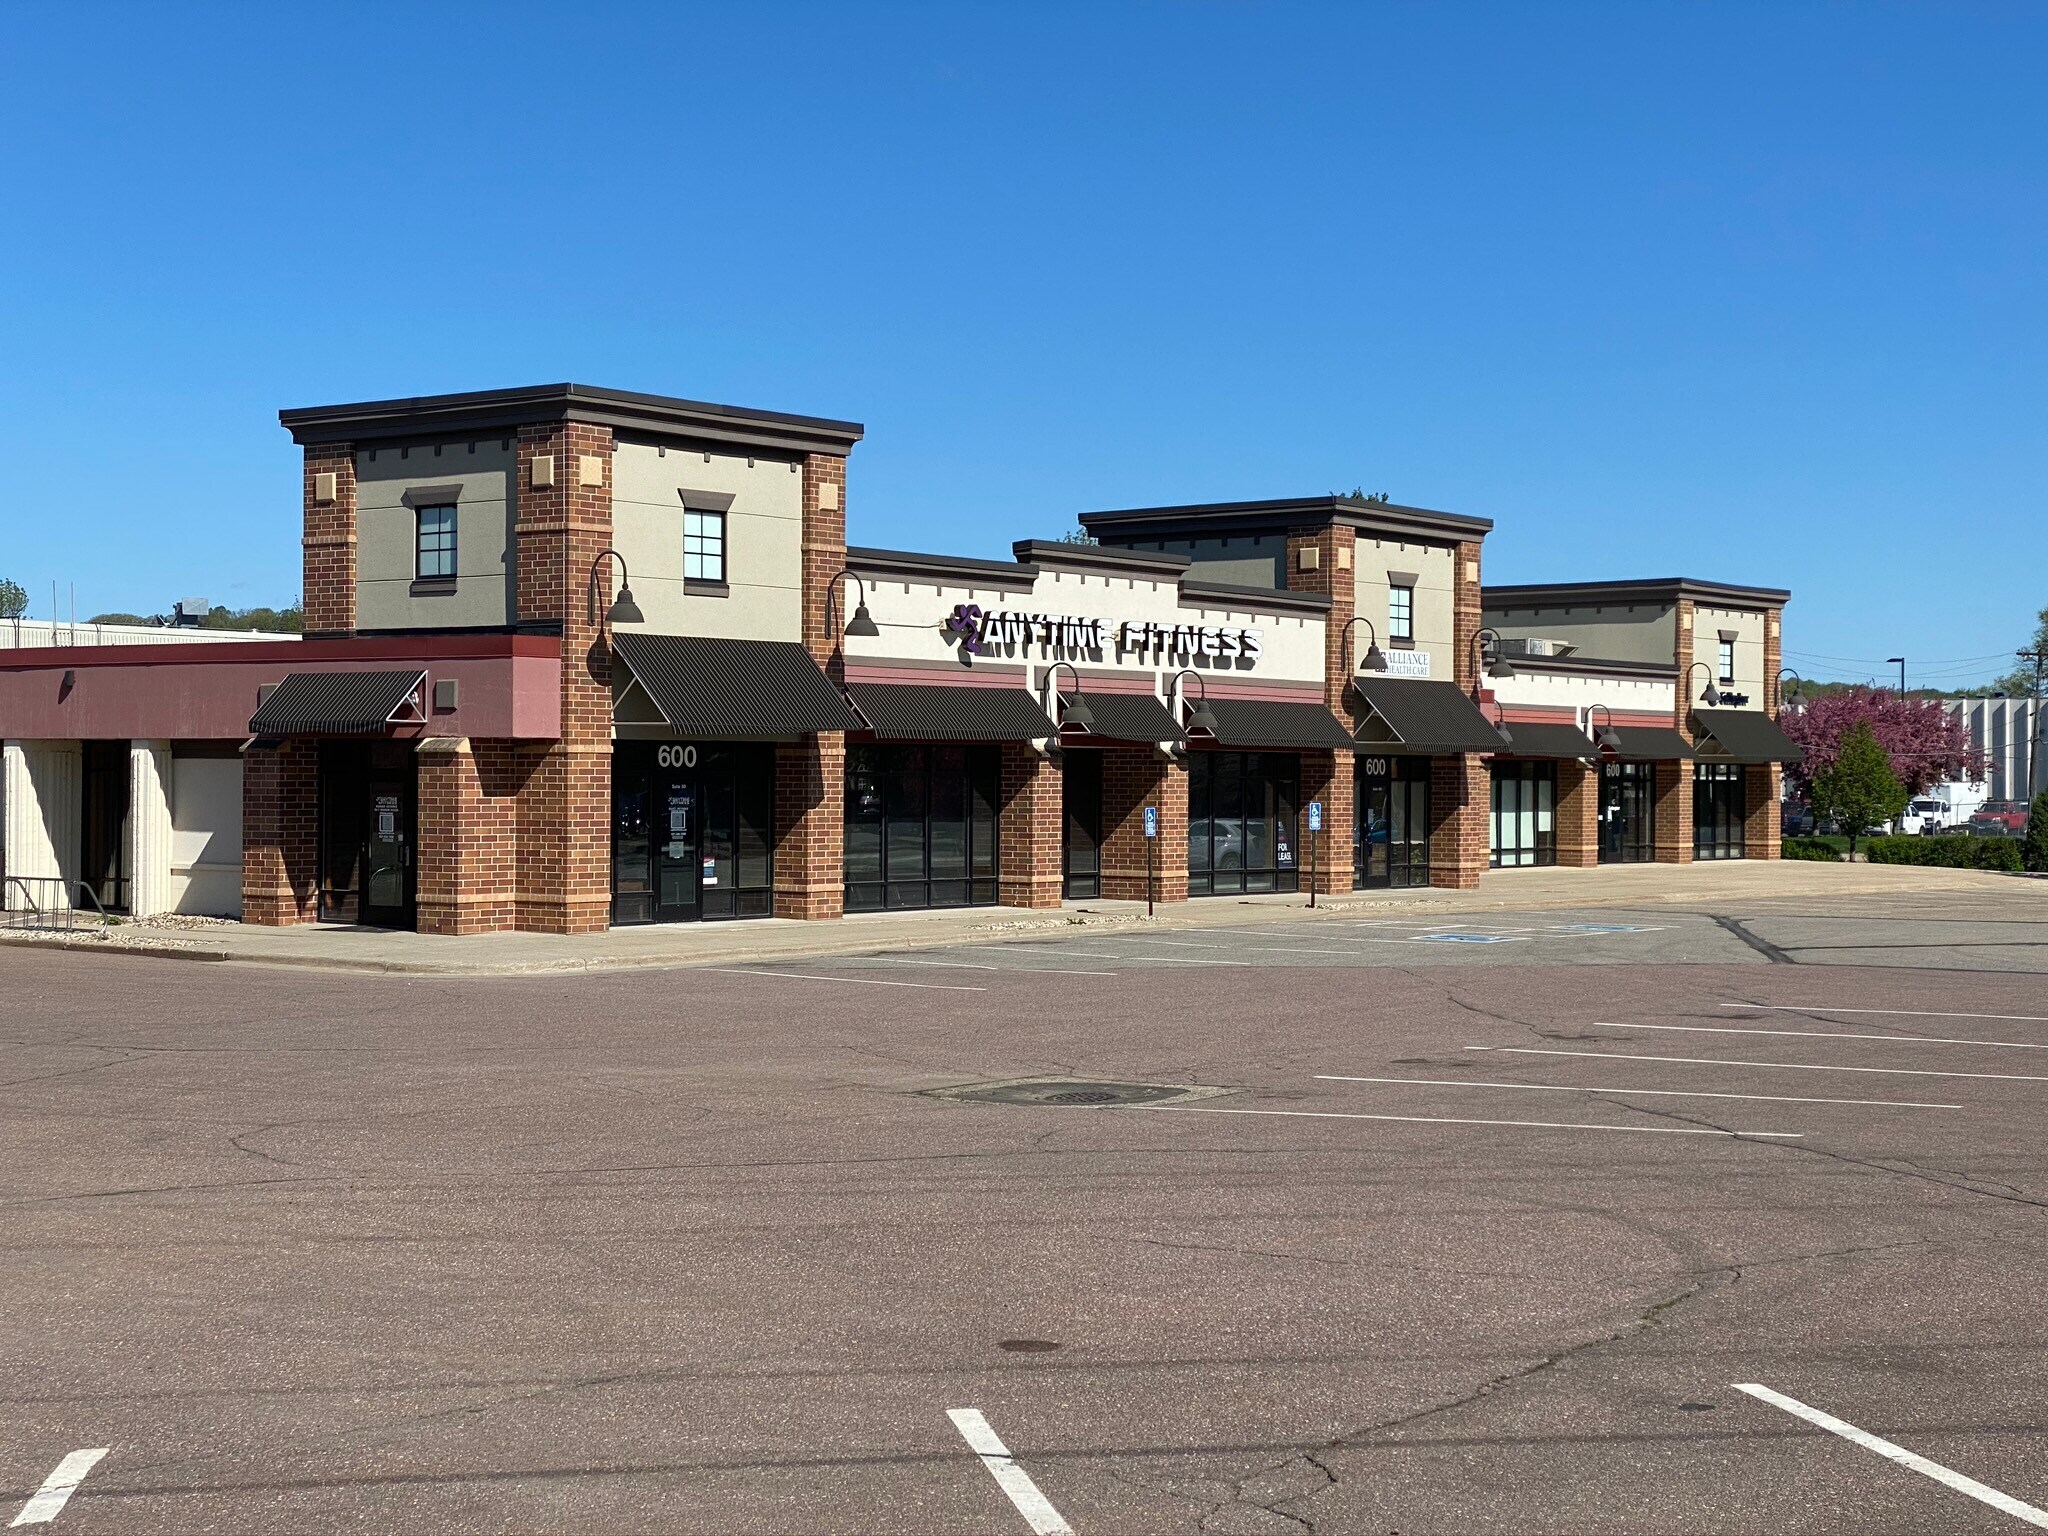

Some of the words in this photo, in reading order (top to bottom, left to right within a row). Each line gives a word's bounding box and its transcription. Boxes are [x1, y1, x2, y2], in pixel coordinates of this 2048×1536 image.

[981, 611, 1113, 649] ANYTIME
[1122, 621, 1264, 658] FITNESS
[1387, 653, 1428, 665] ALLIANCE
[1387, 665, 1411, 674] HEALTH
[1413, 667, 1428, 675] CARE
[657, 745, 697, 768] 600
[1366, 758, 1386, 776] 600
[1606, 763, 1620, 777] 600
[1278, 843, 1287, 851] FOR
